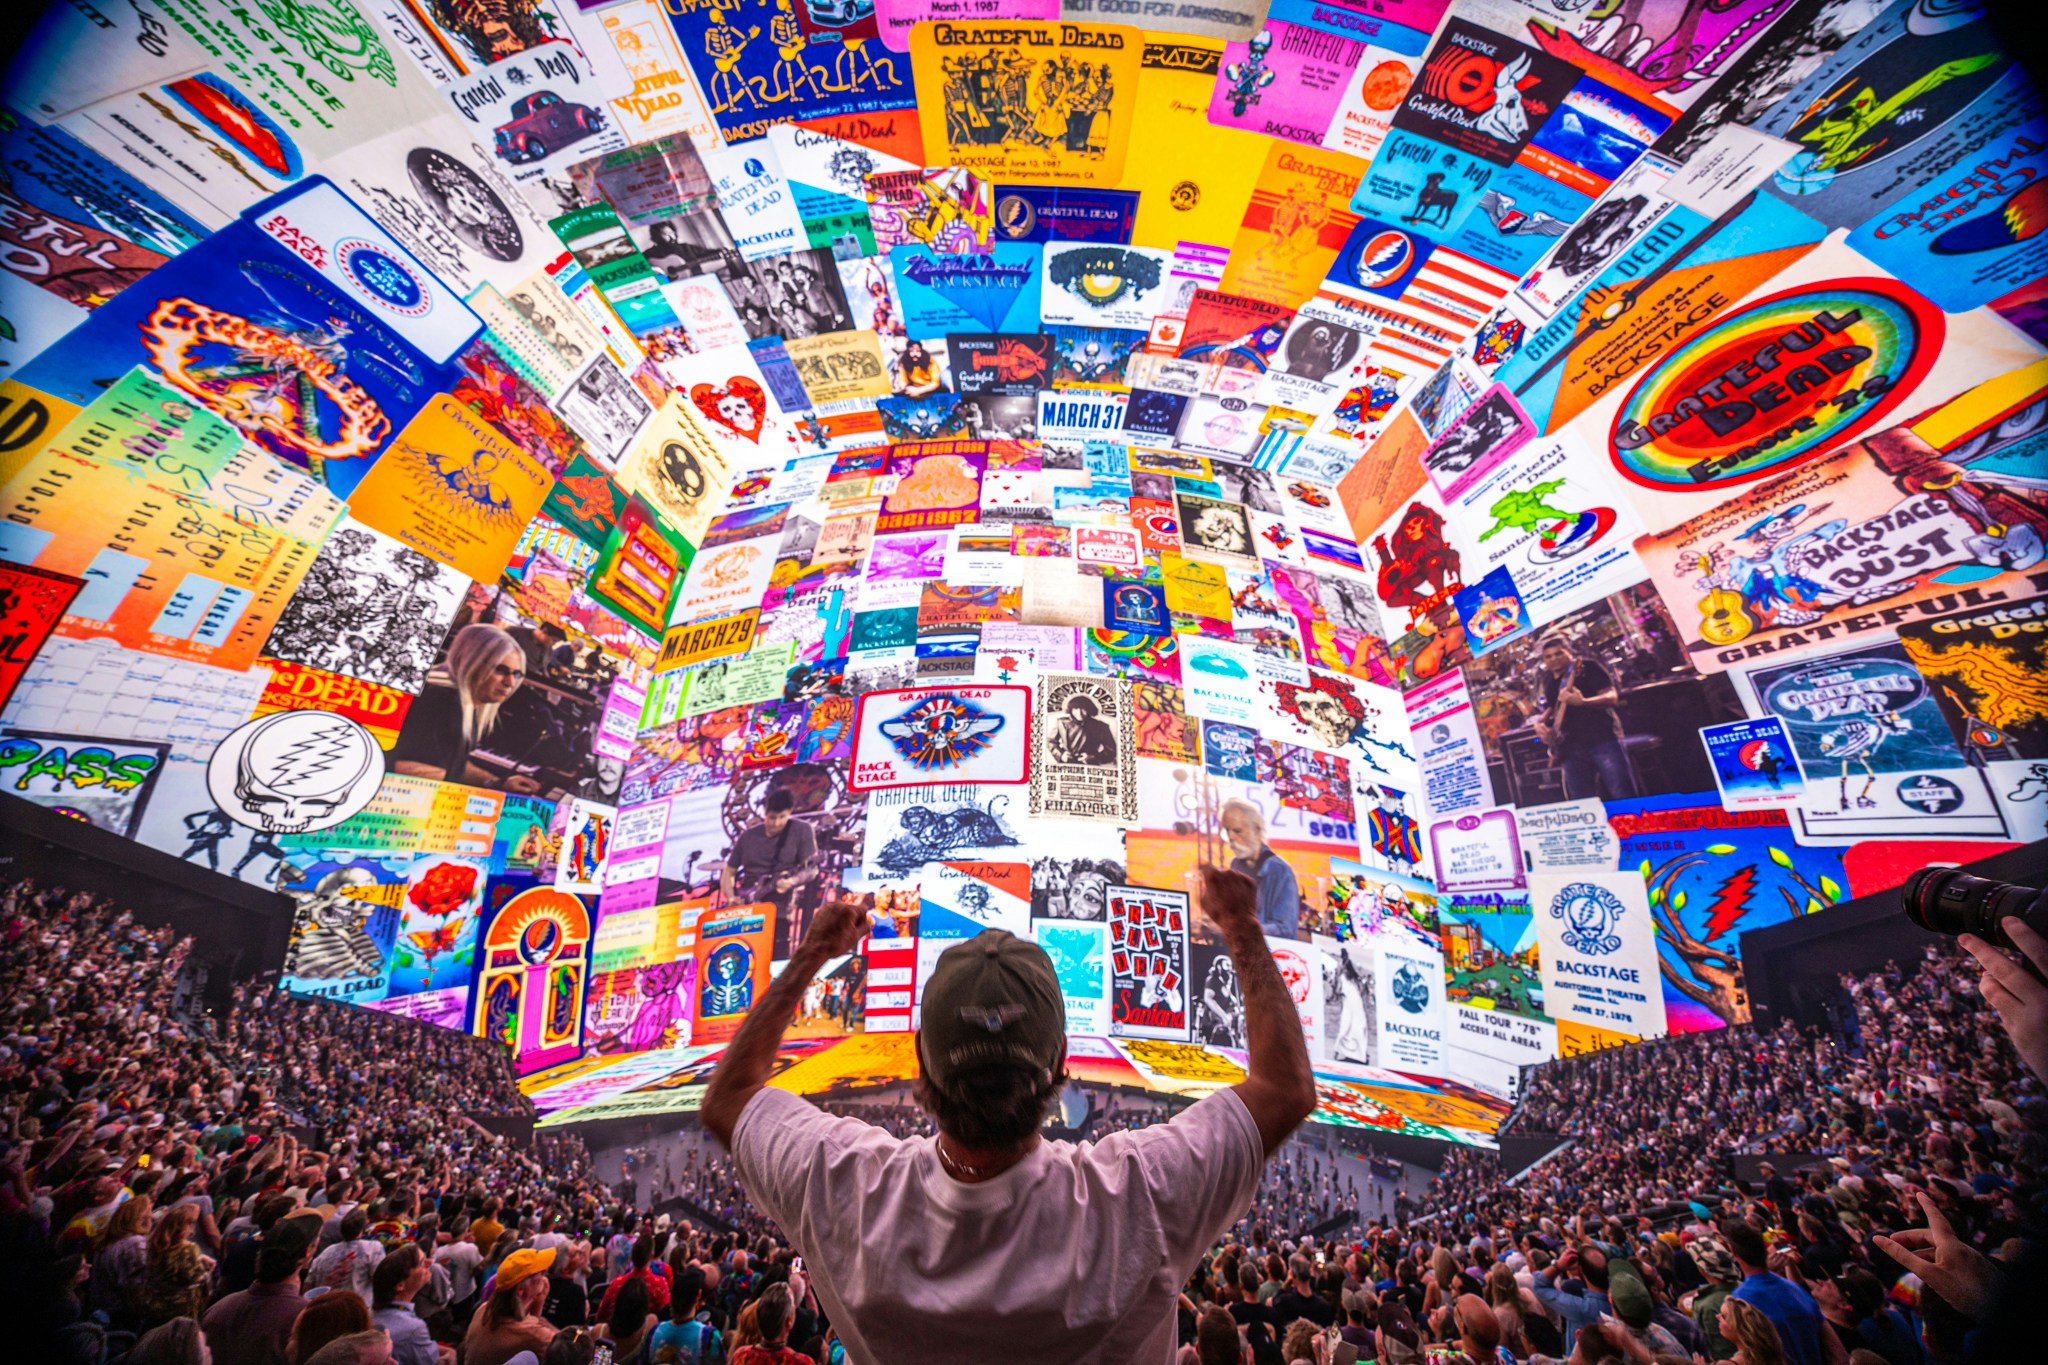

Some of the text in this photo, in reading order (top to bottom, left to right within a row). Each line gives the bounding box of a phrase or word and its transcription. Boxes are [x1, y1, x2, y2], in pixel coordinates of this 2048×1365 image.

[931, 1, 1000, 13] March 1987
[1095, 0, 1137, 16] GOOD
[1142, 1, 1174, 16] FOR
[1176, 4, 1257, 27] ADMISSION
[1310, 5, 1384, 37] BACKSTAGE
[932, 23, 1125, 50] GRATEFUL DEAD
[1280, 24, 1344, 66] GRATEFUL
[1450, 32, 1498, 58] BACKSTAGE
[259, 62, 335, 130] Memorial
[450, 75, 507, 123] Grateful
[634, 92, 683, 123] DEAD
[257, 91, 303, 130] 1976
[1344, 110, 1392, 132] BACKSTAGE
[1407, 93, 1480, 130] Grateful Dead
[794, 119, 897, 148] Grateful Dead
[109, 113, 208, 184] ACCESS ALL AREAS
[1386, 135, 1438, 166] Grateful
[513, 167, 546, 182] Backstage
[949, 156, 1007, 169] BACKSTAGE
[1042, 160, 1062, 169] 1987
[868, 172, 927, 190] GRATEFUL
[1083, 173, 1095, 181] CA
[744, 191, 782, 217] DEAD
[885, 186, 915, 203] DEAD
[1036, 205, 1119, 220] GRATEFUL DEAD
[1634, 199, 1670, 232] DEAD
[262, 221, 329, 271] STAGE
[273, 215, 329, 258] BACK
[736, 227, 796, 249] BACKSTAGE
[358, 259, 410, 303] GRATEFUL
[377, 257, 411, 288] GOOD
[590, 259, 649, 285] BACKSTAGE
[930, 274, 1021, 290] BACKSTAGE
[363, 273, 395, 298] DEAD
[1525, 219, 1686, 364] GRATEFUL DEAD
[1196, 290, 1281, 316] GRATEFUL DEAD
[1675, 300, 1692, 314] CT
[695, 322, 735, 335] BACKSTAGE
[1043, 313, 1075, 323] Backstage
[1302, 307, 1376, 334] GRATEFUL DEAD
[1333, 296, 1449, 345] GRATEFUL DEAD
[1569, 273, 1715, 385] The Arena
[1582, 286, 1685, 367] October 1984
[958, 340, 995, 350] BACKSTAGE
[1586, 292, 1731, 398] BACKSTAGE
[959, 370, 995, 383] Grateful
[960, 380, 981, 392] Dead
[1270, 372, 1331, 397] BACKSTAGE
[1614, 307, 1864, 452] GRATEFUL
[1066, 388, 1091, 397] GOOD
[1698, 343, 1874, 438] DEAD
[1042, 402, 1124, 430] MARCH 31
[1129, 422, 1168, 434] BACKSTAGE
[71, 420, 117, 457] 1980
[843, 438, 887, 450] BACKSTAGE
[1686, 414, 1820, 485] EUROPE
[1498, 443, 1565, 493] Grateful
[1525, 452, 1569, 486] Dead
[1709, 498, 1741, 516] 1991
[1752, 470, 1797, 497] Capital
[1749, 471, 1821, 508] Maryland
[1676, 471, 1850, 550] NOT GOOD FOR ADMISSION
[399, 529, 456, 563] BACKSTAGE
[1486, 520, 1551, 564] Santana
[1800, 497, 1950, 571] BACKSTAGE
[1828, 526, 1957, 590] BUST
[1855, 543, 1891, 561] OR
[163, 591, 186, 620] 335
[686, 585, 752, 607] BACKSTAGE
[771, 583, 845, 604] GRATEFUL
[787, 595, 829, 609] DEAD
[917, 612, 1003, 623] GRATEFUL DEAD
[917, 622, 959, 634] GRATEFUL
[1715, 585, 2011, 667] GRATEFUL
[151, 632, 214, 655] SEC LOC
[661, 617, 753, 662] MARCH 29
[856, 638, 907, 650] BACKSTAGE
[708, 655, 734, 667] DEAD
[1778, 673, 1915, 712] GRATEFUL
[1809, 672, 1855, 688] THE
[289, 671, 399, 717] DEAD
[899, 688, 992, 703] GRATEFUL DEAD
[1193, 687, 1254, 705] BACKSTAGE
[1806, 692, 1889, 722] DEAD
[1707, 725, 1781, 747] GRATEFUL DEAD
[0, 737, 157, 795] PASS
[858, 761, 892, 773] BACK
[1292, 752, 1351, 775] GRATEFUL
[1308, 764, 1343, 780] DEAD
[857, 771, 898, 785] STAGE
[874, 783, 977, 807] GRATEFUL DEAD
[1909, 788, 1946, 801] STAFF
[1309, 819, 1356, 841] seat
[1449, 842, 1491, 854] GRATEFUL
[867, 870, 910, 882] Backstage
[939, 866, 1012, 885] Grateful Dead
[714, 907, 754, 920] BACKSTAGE
[1550, 881, 1626, 922] GRATEFUL
[1166, 934, 1183, 943] APRIL
[1560, 931, 1623, 957] DEAD
[1554, 959, 1641, 984] BACKSTAGE
[343, 977, 387, 994] DEAD
[1553, 980, 1648, 1004] AUDITORIUM THEATER
[1111, 988, 1186, 1029] Santana
[1458, 1007, 1512, 1030] FALL TOUR
[1571, 1003, 1596, 1018] JUNE
[1384, 1021, 1442, 1042] BACKSTAGE
[1459, 1021, 1543, 1050] ACCESS ALL AREAS
